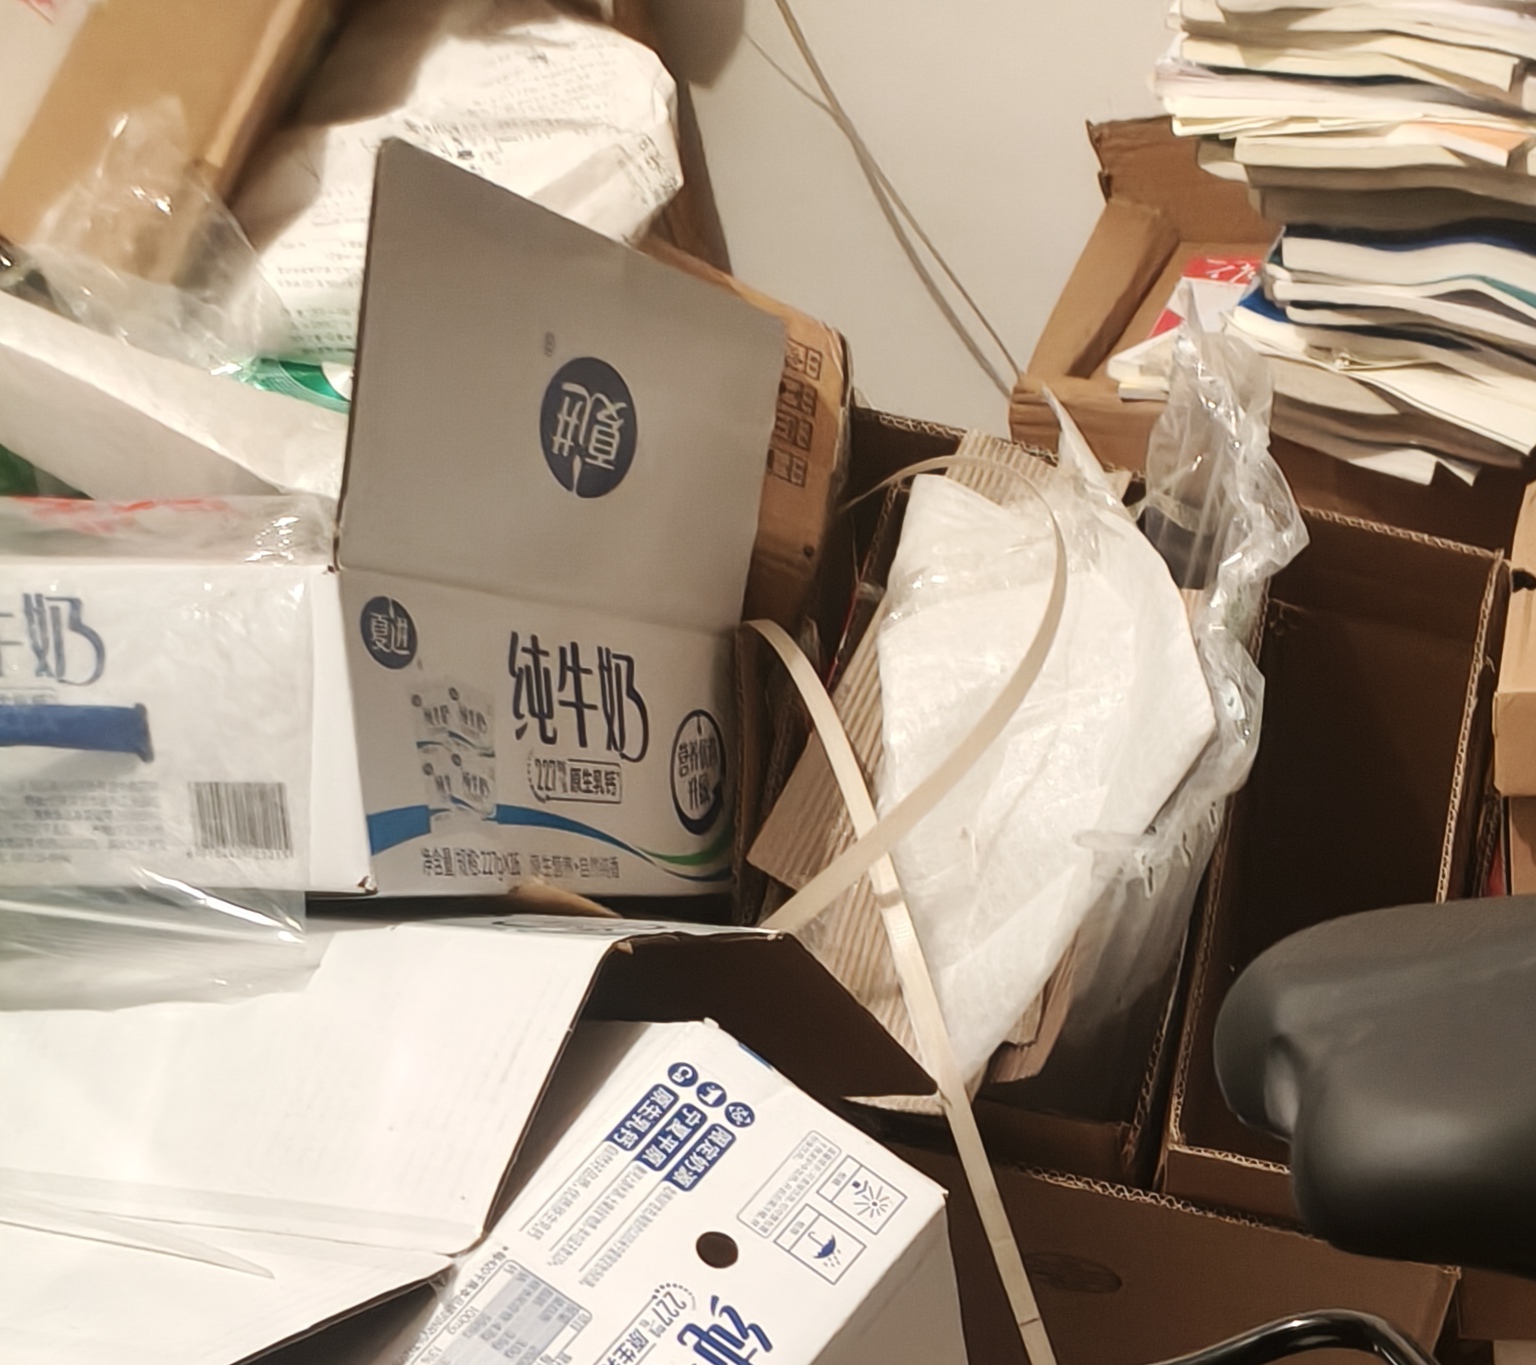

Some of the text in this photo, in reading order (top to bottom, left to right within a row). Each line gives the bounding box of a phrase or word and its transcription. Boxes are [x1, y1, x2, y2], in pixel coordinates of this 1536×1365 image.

[551, 382, 627, 470] 夏进
[0, 592, 105, 686] 奶
[370, 612, 411, 655] 夏进
[508, 631, 649, 763] 纯牛奶
[670, 1063, 694, 1086] Ca
[610, 1085, 675, 1149] 原生乳钙
[639, 1104, 704, 1169] 宁夏平原
[668, 1124, 734, 1189] 限定奶源
